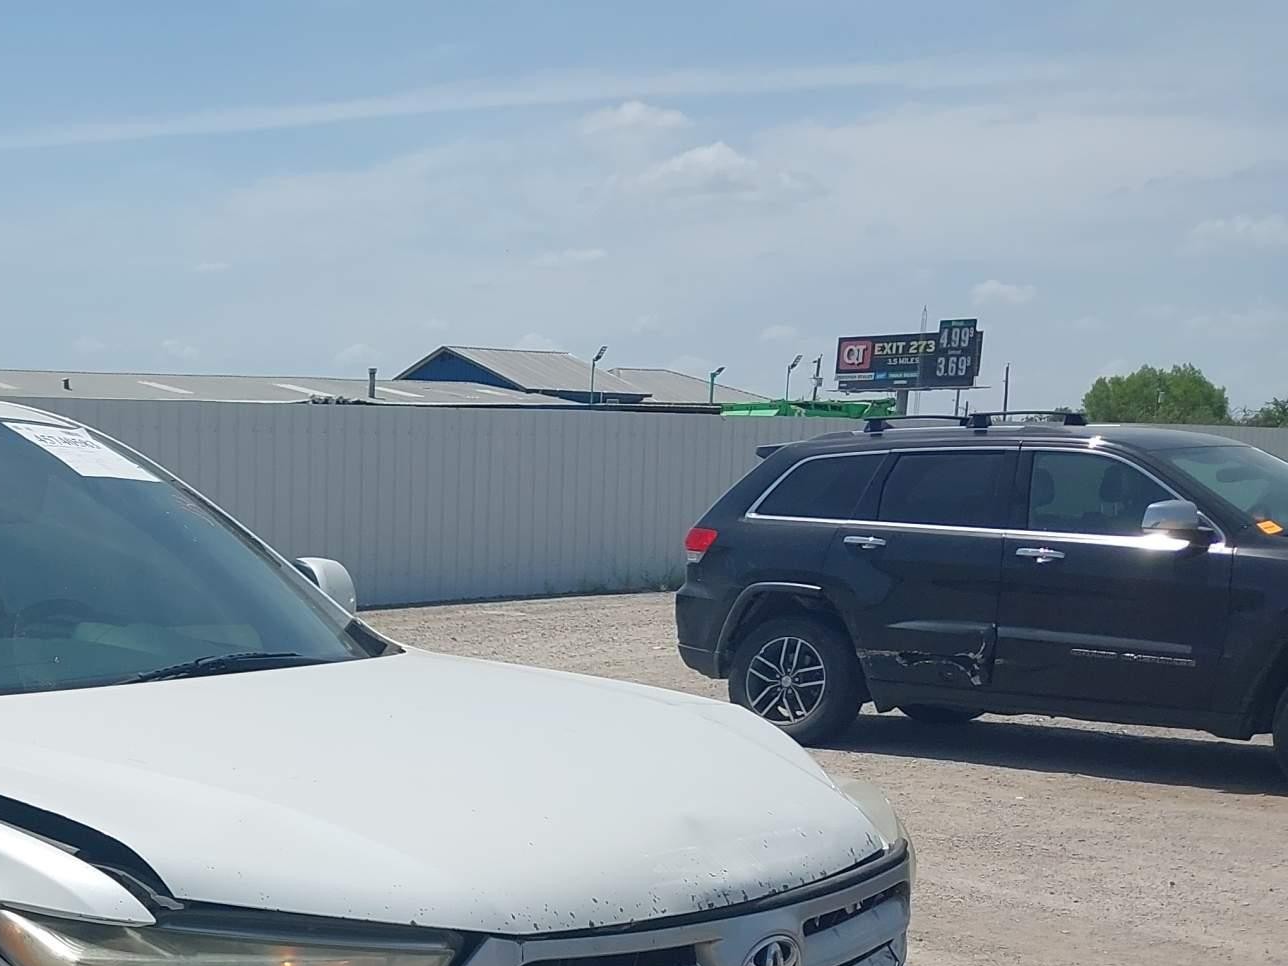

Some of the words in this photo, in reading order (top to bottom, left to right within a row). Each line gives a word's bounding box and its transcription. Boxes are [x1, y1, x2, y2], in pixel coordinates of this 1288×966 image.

[843, 345, 868, 366] QT
[874, 341, 906, 355] EXIT
[908, 340, 936, 354] 273
